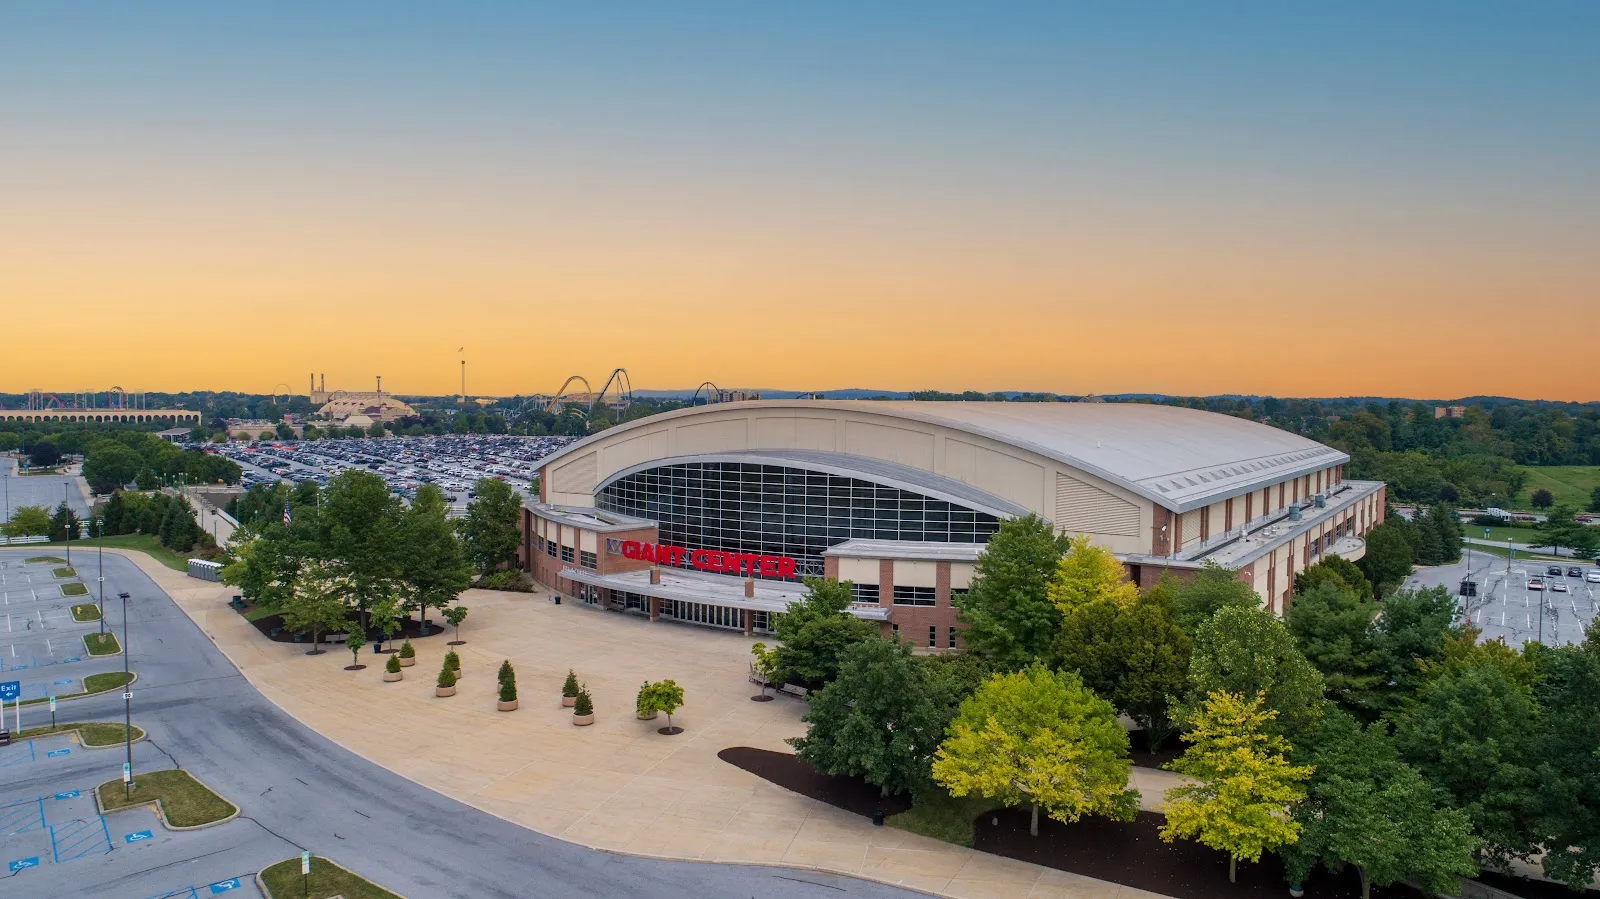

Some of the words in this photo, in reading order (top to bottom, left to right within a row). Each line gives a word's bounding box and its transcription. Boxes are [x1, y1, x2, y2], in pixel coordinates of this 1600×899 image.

[621, 540, 686, 566] GIANT
[690, 548, 796, 579] CENTER
[1, 684, 17, 692] Exit
